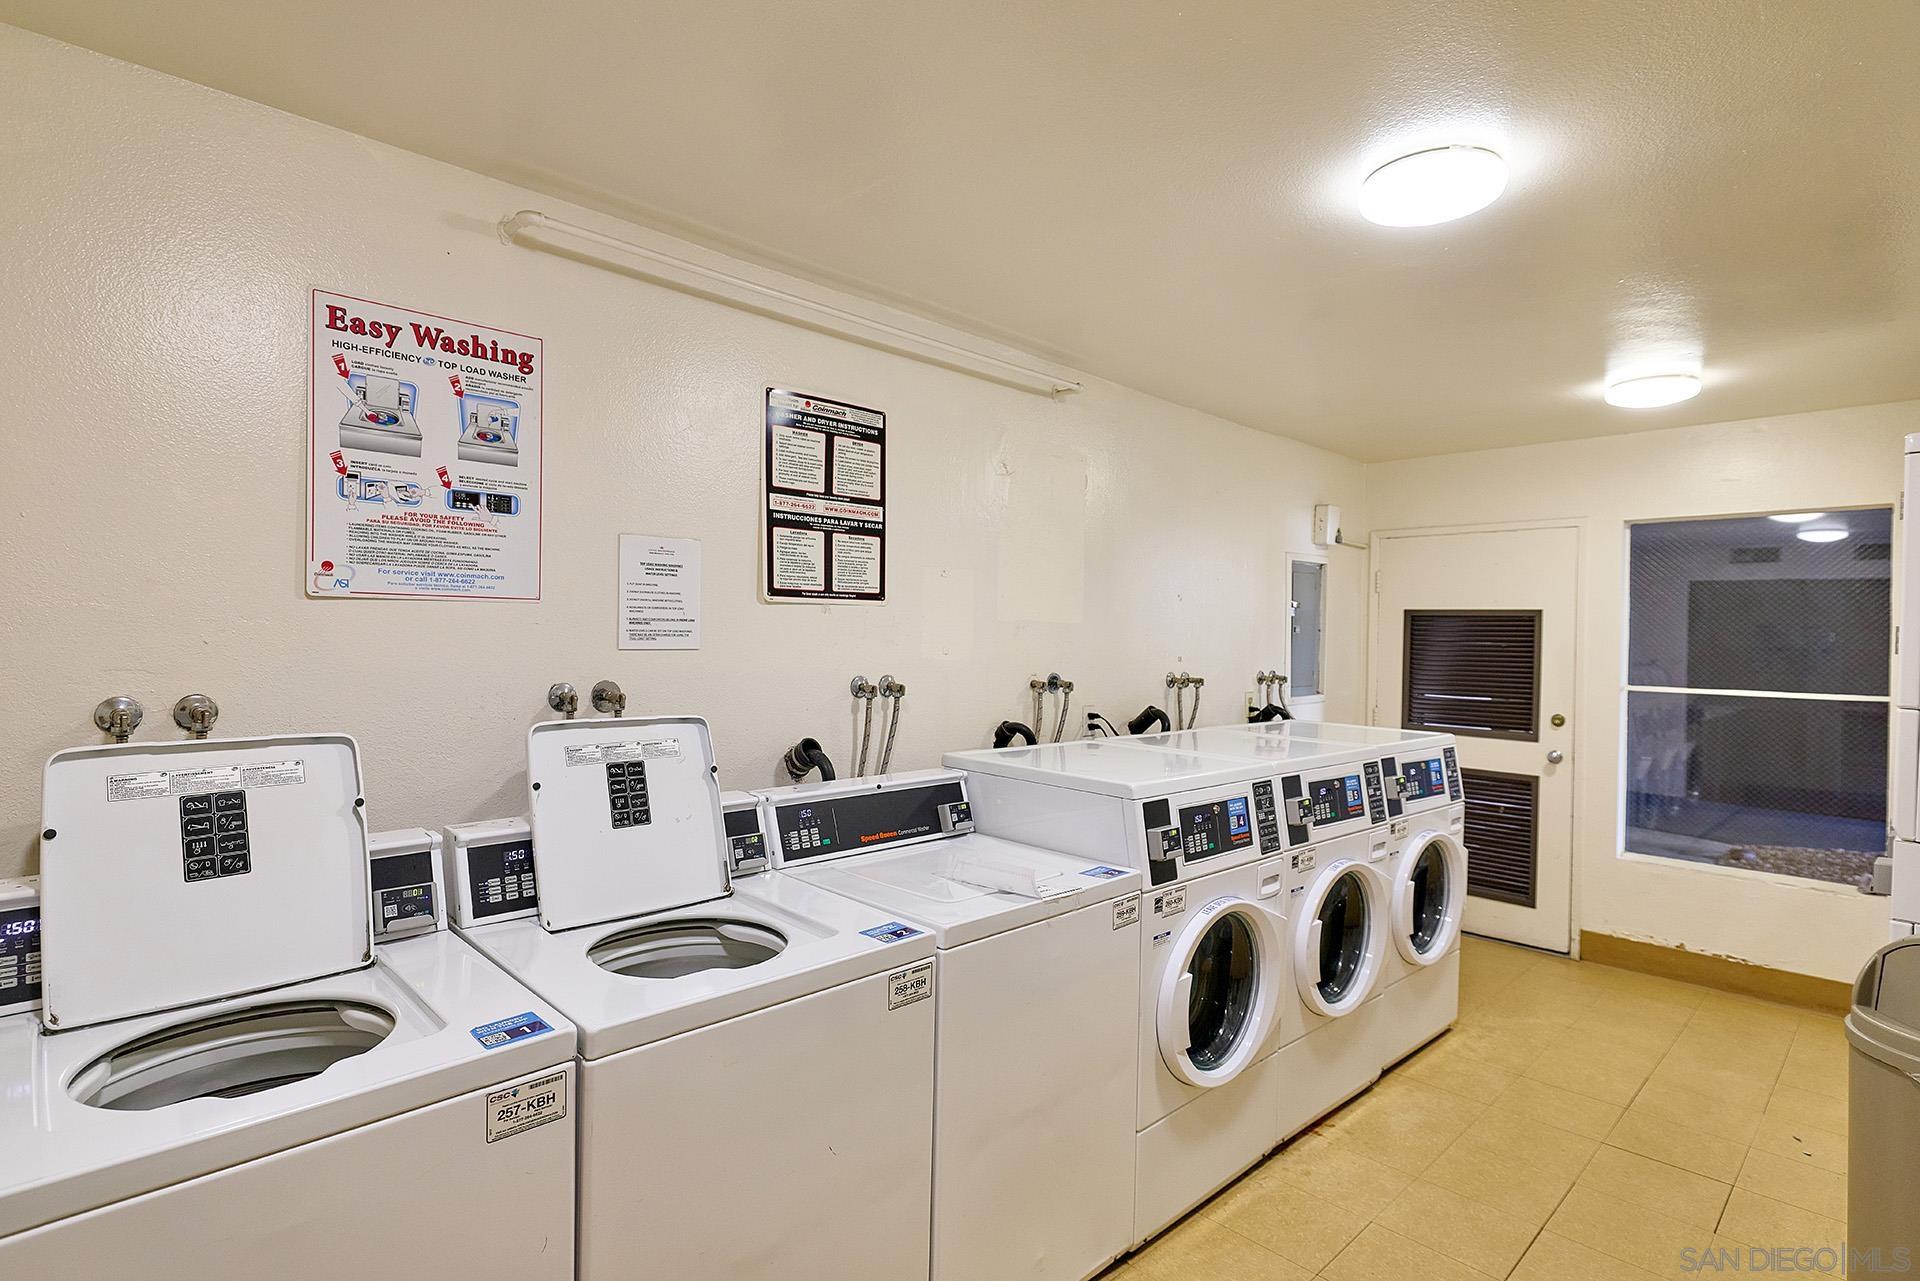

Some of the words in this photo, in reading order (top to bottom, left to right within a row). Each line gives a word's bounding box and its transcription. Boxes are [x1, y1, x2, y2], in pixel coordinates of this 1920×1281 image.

[326, 304, 402, 348] Easy
[409, 322, 534, 375] Washing
[332, 340, 421, 363] HIGH-EFFICIENCY
[438, 360, 457, 370] TOP
[460, 364, 486, 375] LOAD
[488, 369, 527, 383] WASHER
[454, 383, 460, 391] 2
[812, 404, 847, 417] Coinmach
[803, 415, 816, 423] AND
[817, 418, 836, 427] DRYER
[838, 422, 878, 435] INSTRUCTIONS
[337, 460, 344, 468] 3
[441, 475, 448, 483] 4
[447, 519, 484, 527] FOLLOWING
[773, 512, 821, 523] INSTRUCCIONES
[823, 517, 838, 525] PARA
[839, 519, 857, 527] LAVAR
[437, 571, 504, 579] www.coinmach.com
[1353, 790, 1359, 799] 5
[1239, 816, 1245, 826] 4
[861, 833, 879, 843] Speed
[879, 830, 897, 841] Queen
[894, 978, 926, 995] 258-KBH
[520, 1025, 532, 1033] 1
[489, 1092, 511, 1104] CSC
[497, 1092, 556, 1121] 257-KBH
